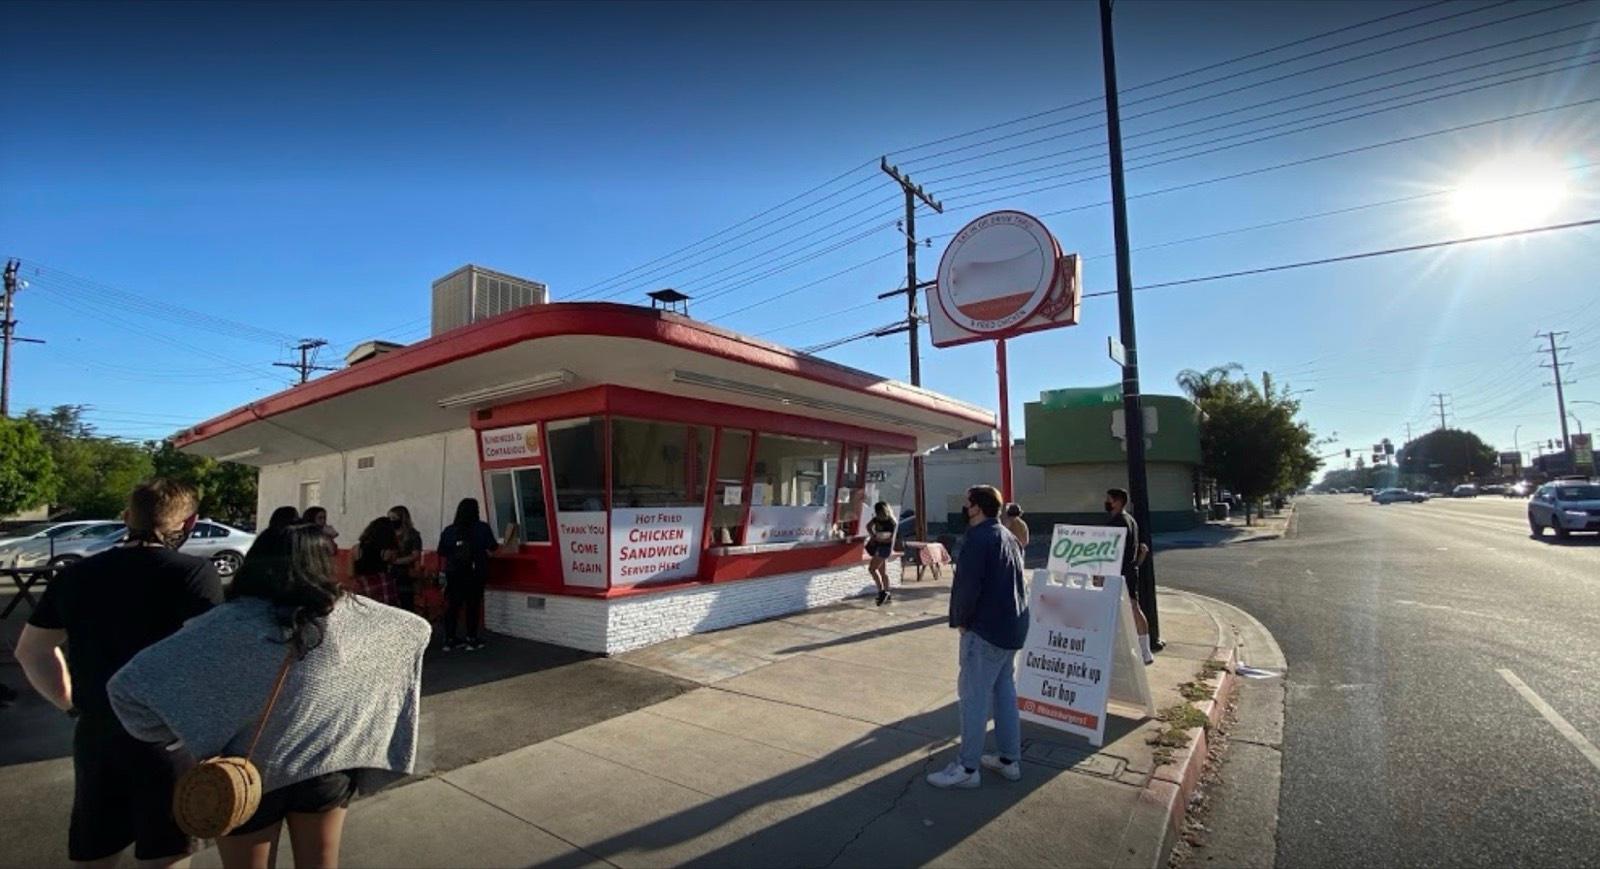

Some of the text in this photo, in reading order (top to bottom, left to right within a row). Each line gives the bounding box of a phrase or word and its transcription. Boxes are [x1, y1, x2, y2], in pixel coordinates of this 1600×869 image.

[635, 512, 682, 524] HOT FRIED
[560, 523, 605, 535] THANK YOU
[629, 529, 684, 542] CHICKEN
[570, 541, 599, 554] COME
[620, 544, 689, 561] SANDWICH
[1053, 534, 1121, 563] Open!
[572, 560, 602, 573] AGAIN
[621, 561, 681, 576] SERVED HERE
[1048, 630, 1086, 652] Take out
[1026, 651, 1101, 684] Curbside pick up
[1041, 680, 1077, 706] Car hop
